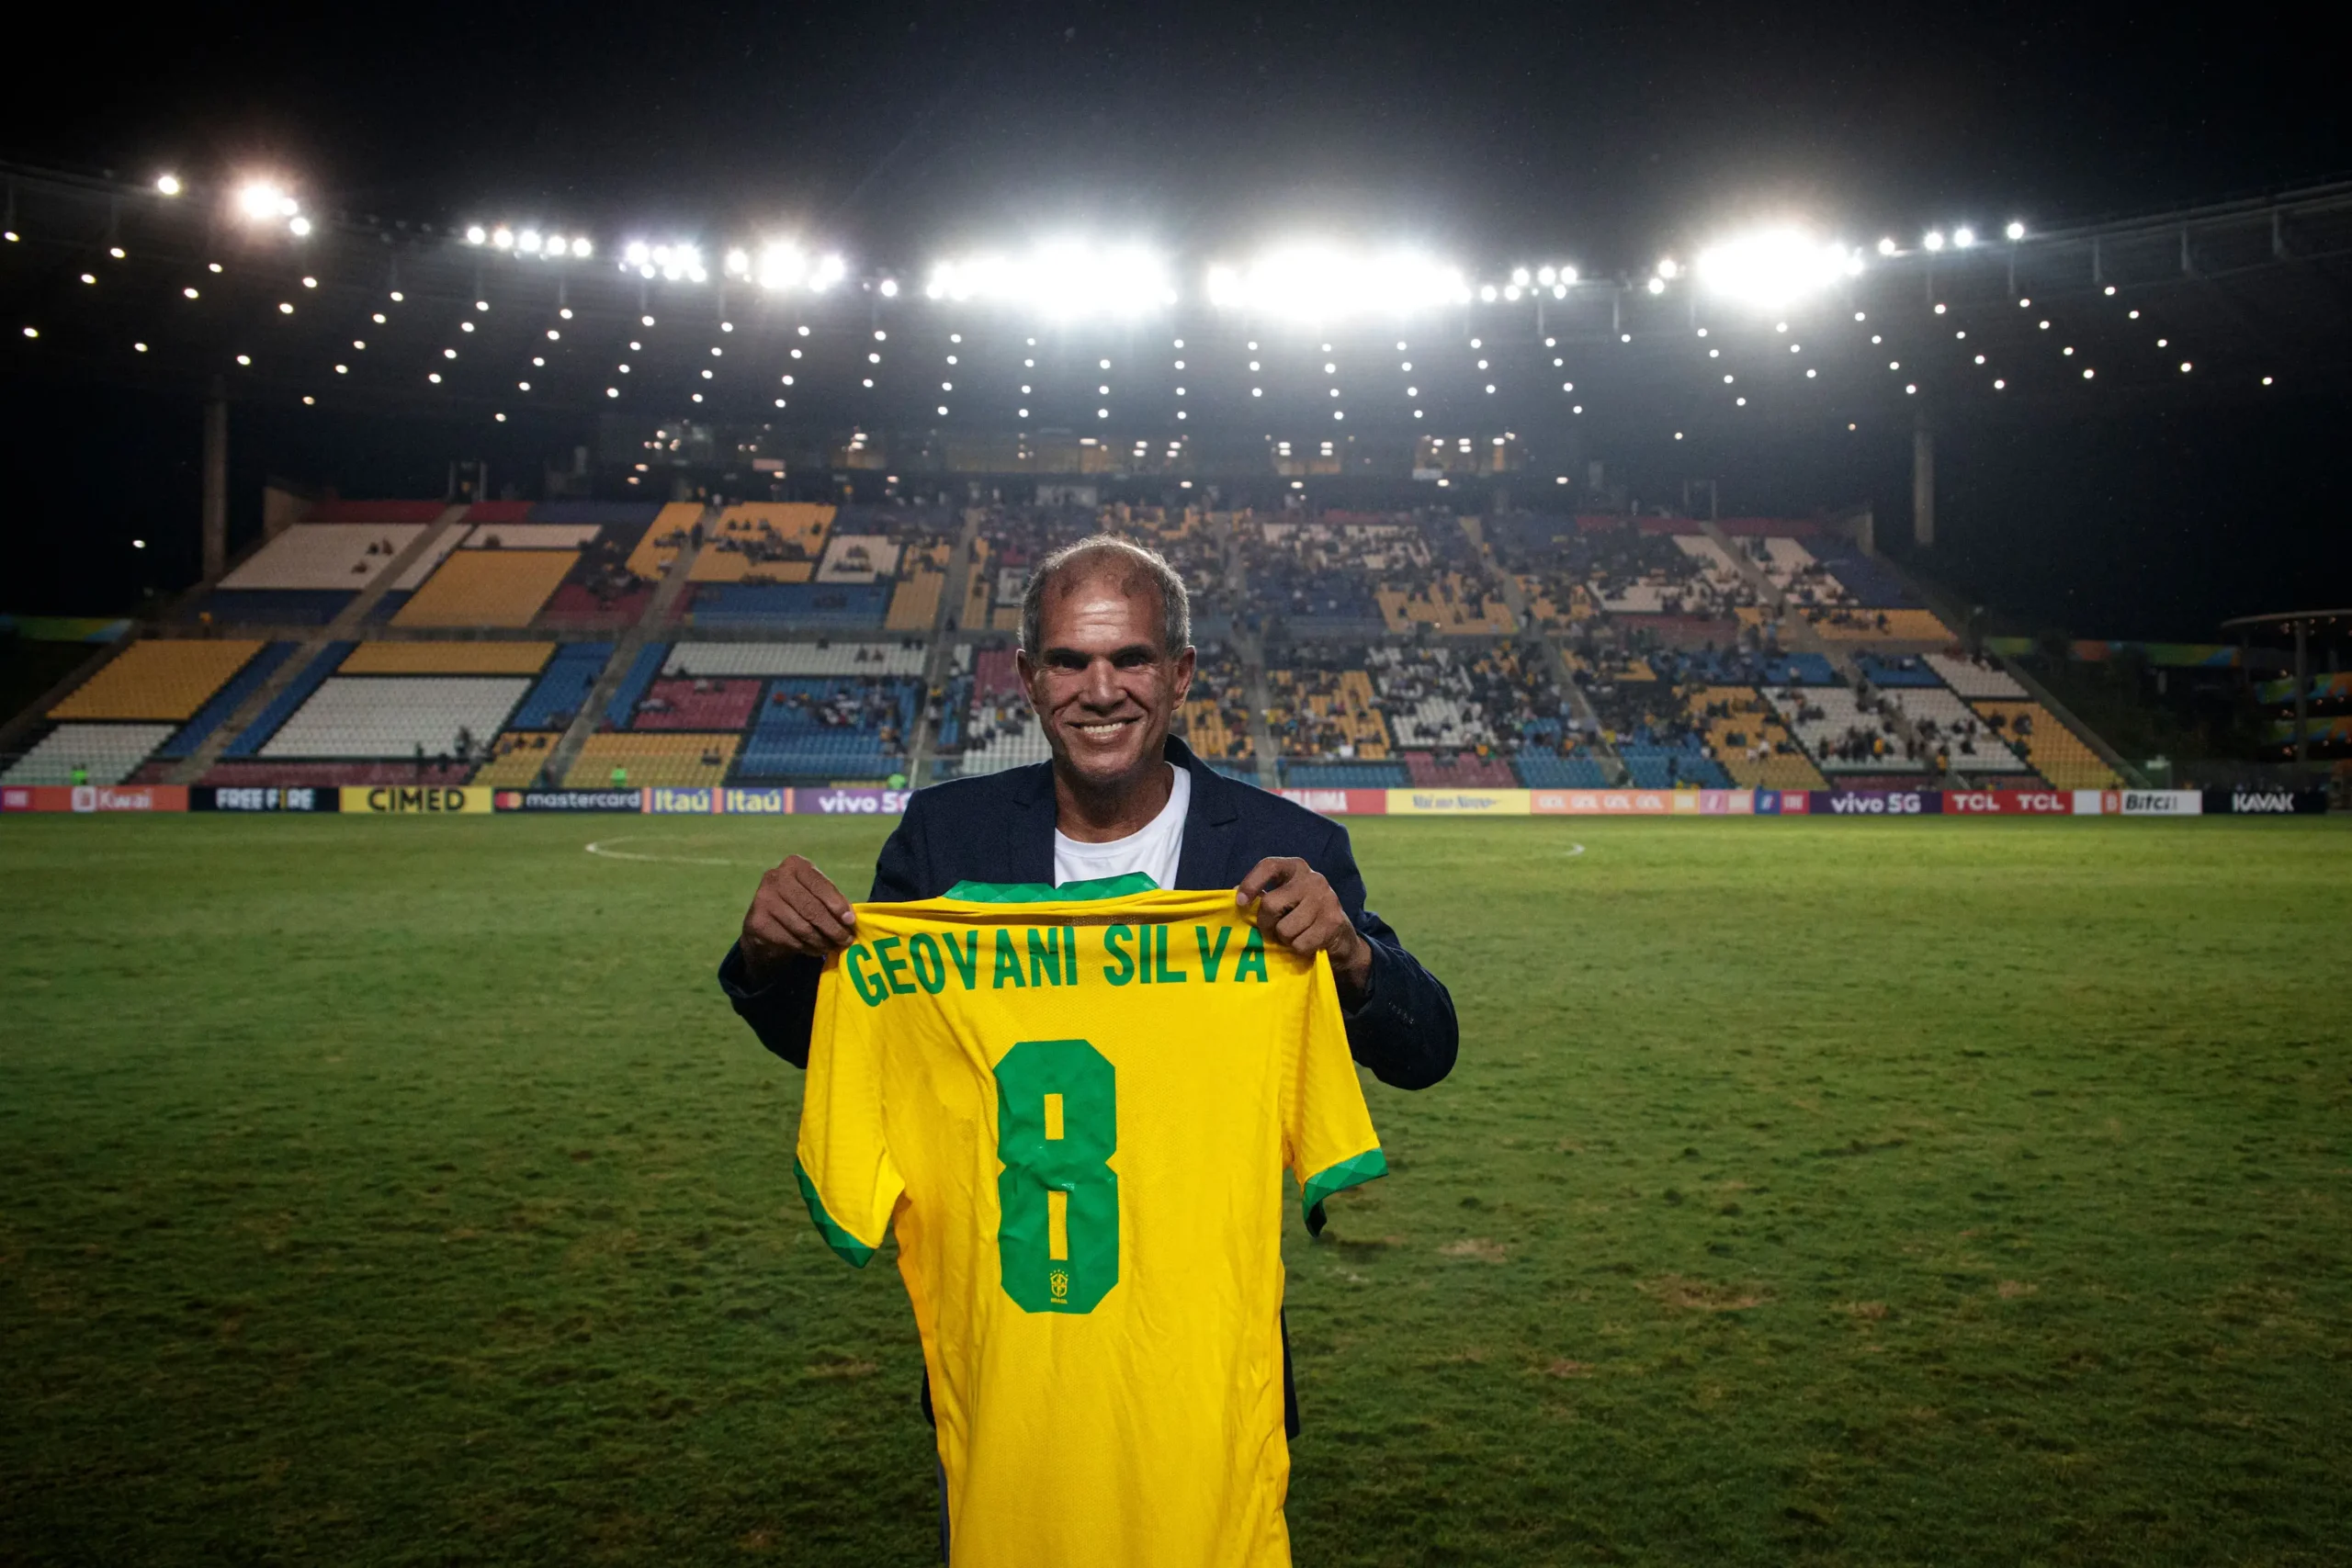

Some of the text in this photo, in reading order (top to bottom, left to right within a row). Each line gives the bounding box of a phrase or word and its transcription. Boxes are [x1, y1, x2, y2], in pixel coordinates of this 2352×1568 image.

[98, 788, 153, 809] Kwai
[215, 787, 313, 809] FREE FIRE
[368, 788, 466, 812] CIMED
[526, 791, 641, 809] mastercard
[654, 789, 709, 812] Itaú
[727, 789, 781, 812] Itaú
[818, 790, 879, 813] vivo
[1830, 791, 1922, 814] vivo 5G
[1952, 794, 2064, 811] TCL TCL
[2233, 792, 2295, 812] KAVAK
[845, 923, 1269, 1008] GEOVANI SILVA
[992, 1038, 1120, 1314] 8
